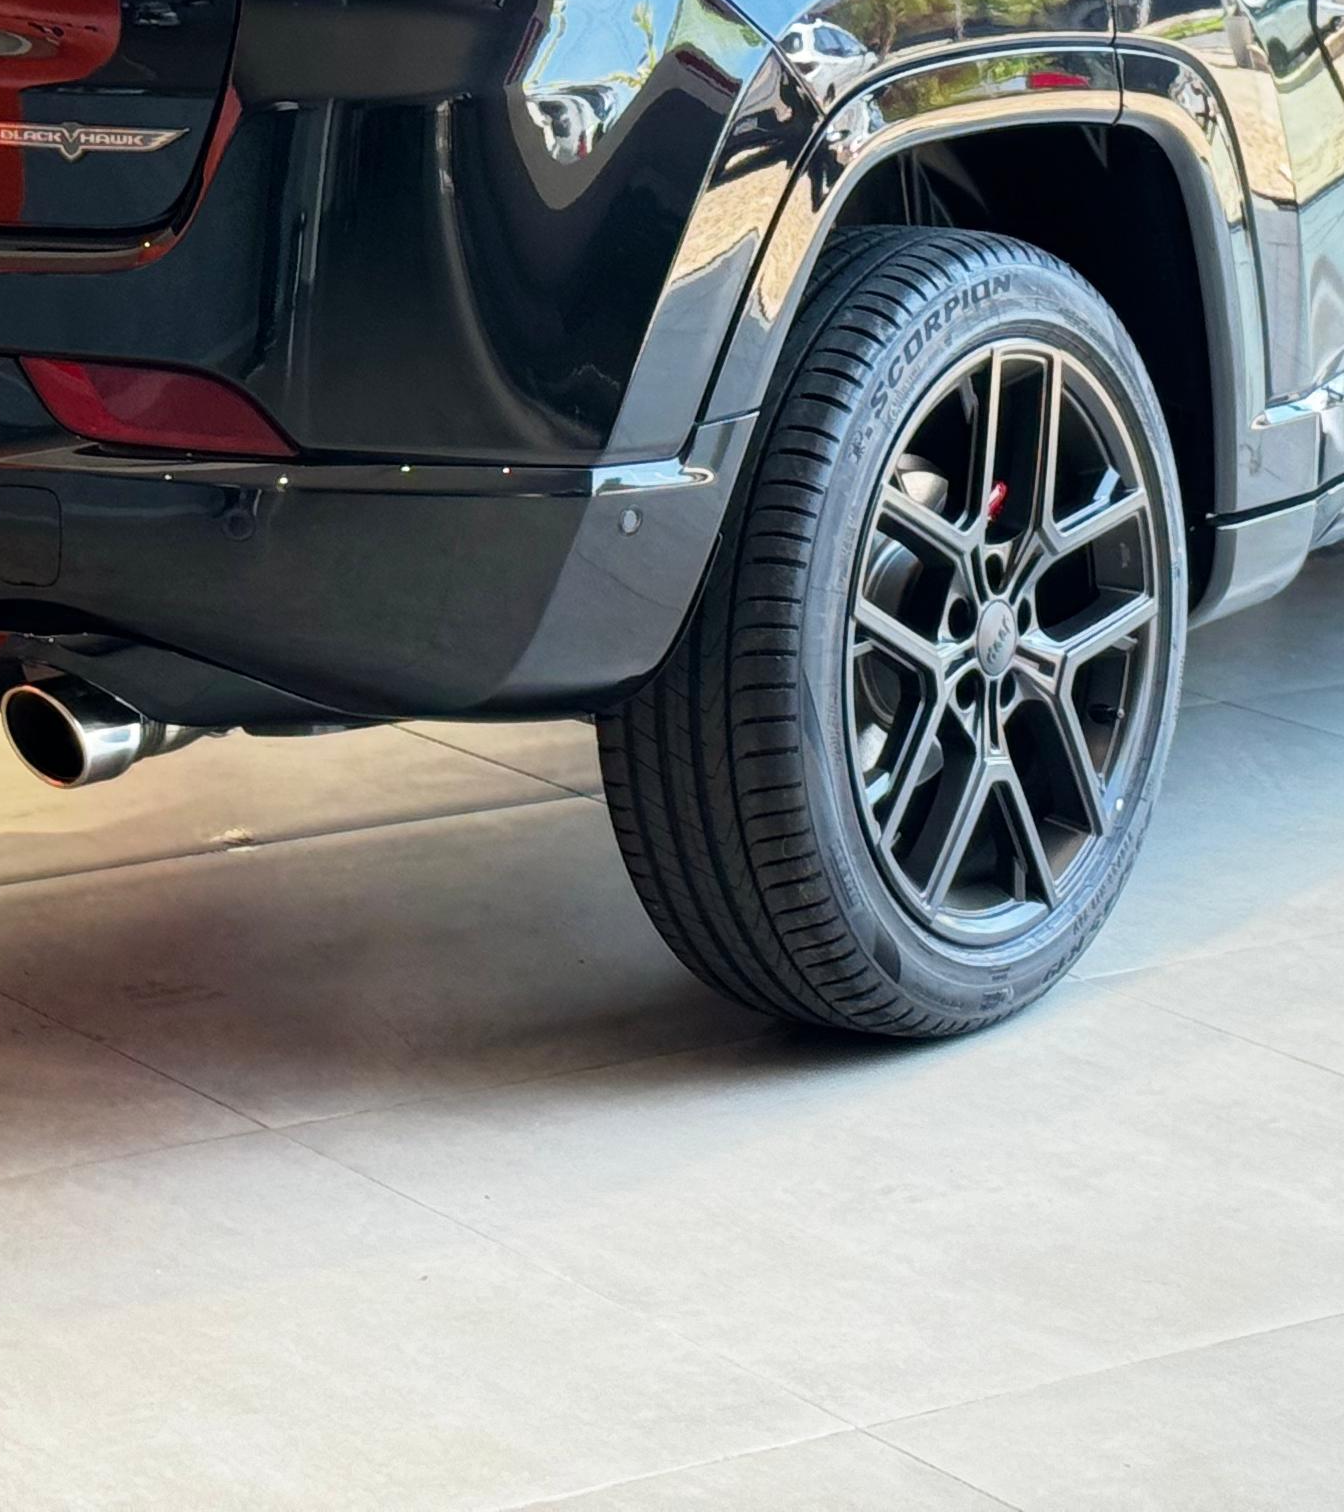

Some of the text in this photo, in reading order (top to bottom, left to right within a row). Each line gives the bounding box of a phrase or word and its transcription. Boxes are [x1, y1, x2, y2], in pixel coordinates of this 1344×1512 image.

[0, 129, 145, 146] BLACK HAWK
[870, 274, 1012, 419] SCORPION
